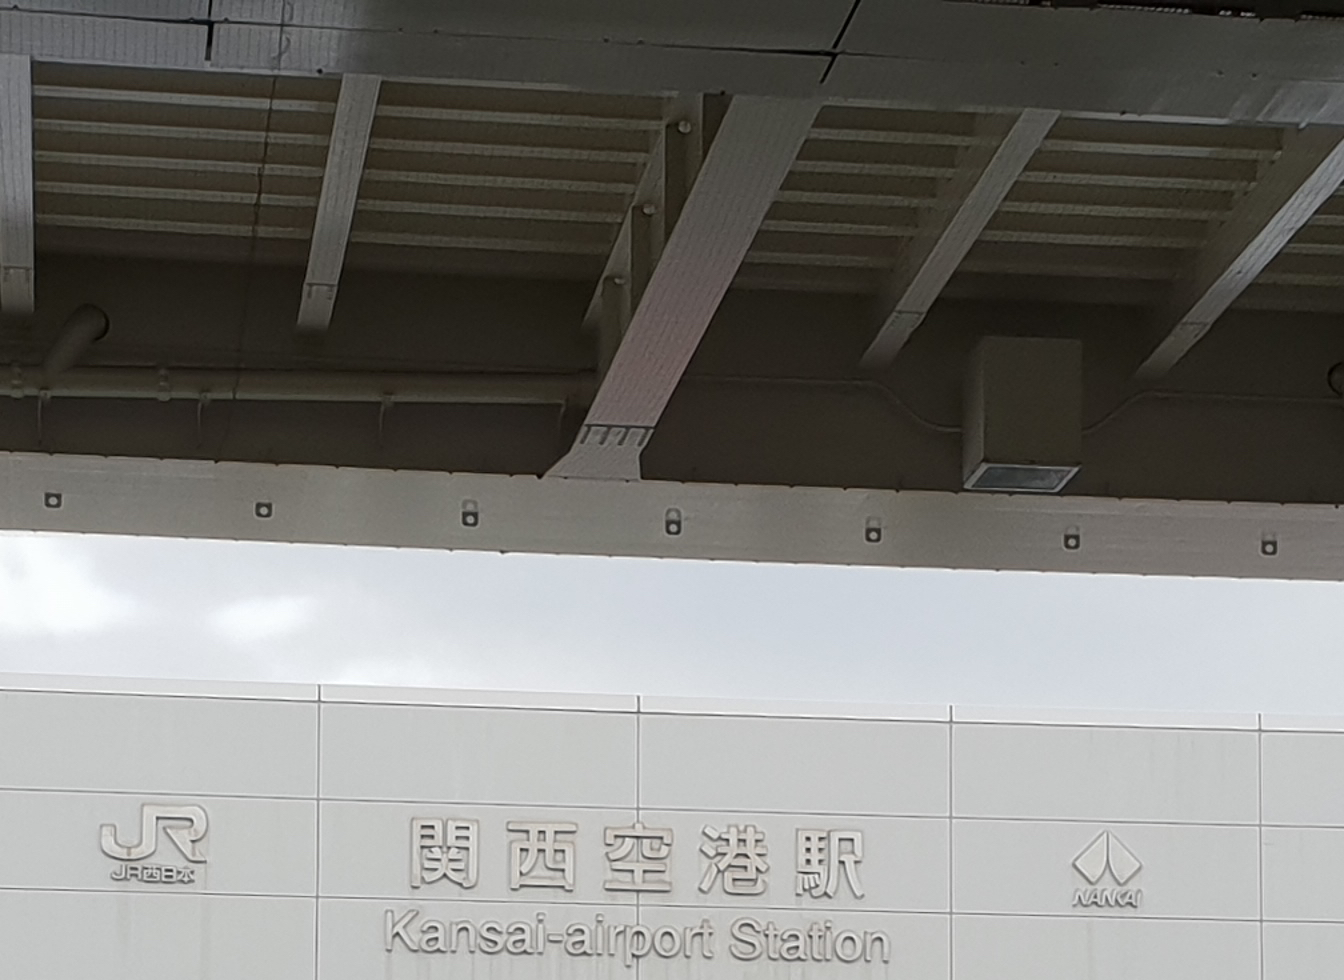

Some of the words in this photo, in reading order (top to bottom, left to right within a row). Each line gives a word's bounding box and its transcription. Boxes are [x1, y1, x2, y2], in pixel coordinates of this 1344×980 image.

[100, 803, 209, 864] JR
[409, 816, 865, 899] 関西空港駅
[110, 864, 195, 884] JR西日本
[1072, 888, 1143, 908] NANKAI
[384, 909, 714, 967] Kansai-airport
[729, 916, 891, 963] Station
